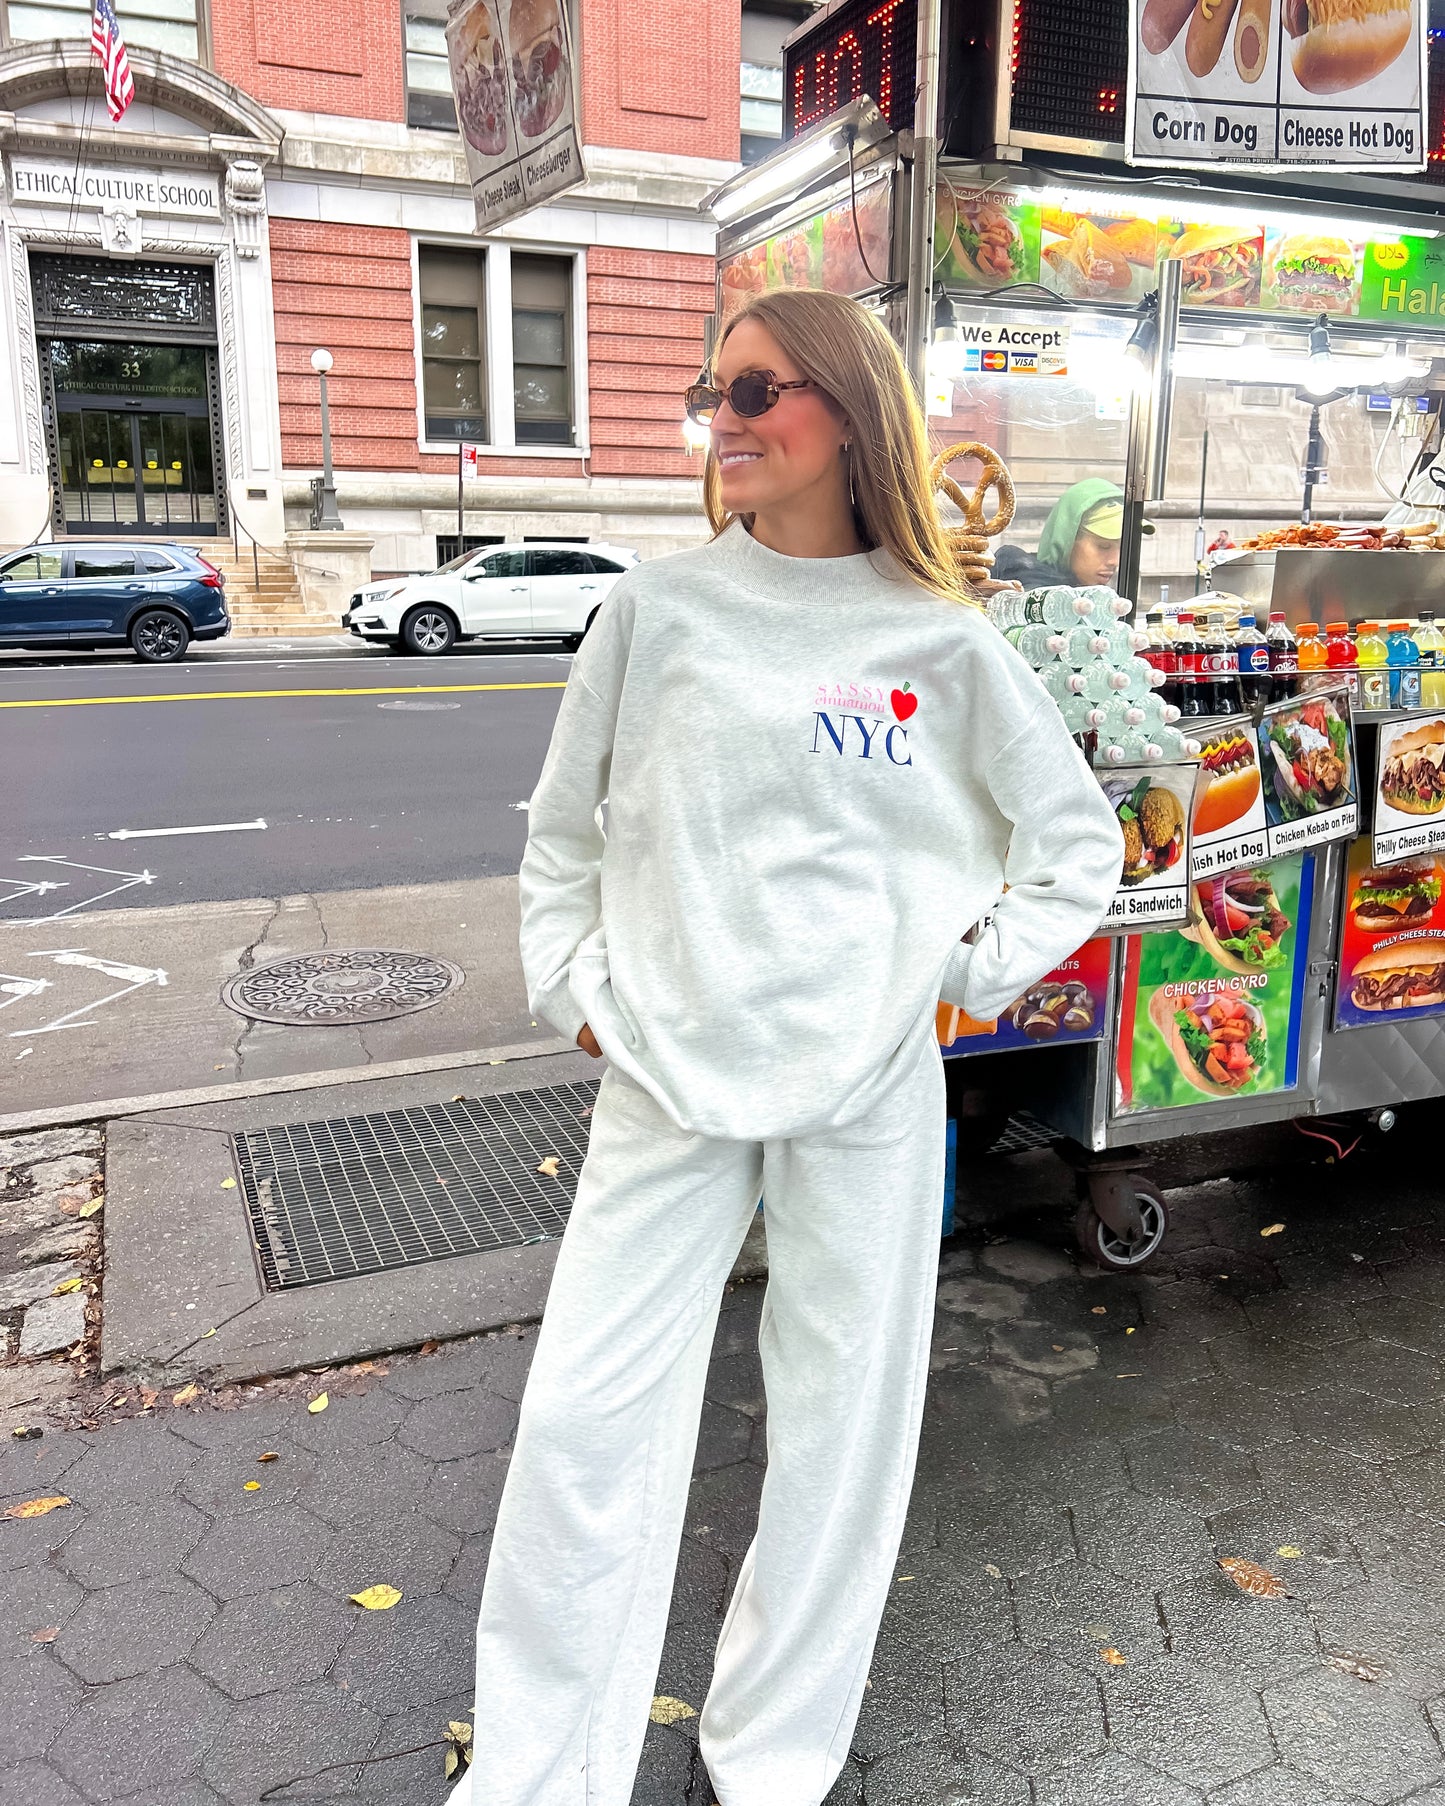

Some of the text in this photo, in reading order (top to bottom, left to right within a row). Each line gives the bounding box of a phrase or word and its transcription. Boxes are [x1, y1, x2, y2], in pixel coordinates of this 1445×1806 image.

[1152, 111, 1258, 151] Corn Dog
[1284, 118, 1414, 153] Cheese Hot Dog
[526, 147, 572, 186] Cheeseburger
[15, 171, 218, 209] ETHICAL CULTURE SCHOOL
[503, 174, 521, 200] Steak
[1378, 245, 1405, 260] حلال
[962, 326, 1062, 350] We Accept
[121, 362, 142, 378] 33
[1014, 357, 1034, 367] VISA
[97, 383, 130, 392] CULTURE
[818, 682, 884, 701] SASSY
[808, 711, 913, 767] NYC
[1275, 813, 1355, 845] Chicken Kebab on Pita
[1217, 847, 1238, 864] Hot
[1241, 842, 1263, 857] Dog
[1376, 839, 1397, 855] Philly
[1398, 835, 1426, 849] Cheese
[1129, 894, 1182, 914] Sandwich
[1372, 935, 1398, 952] PHILLY
[1399, 929, 1427, 940] CHEESE
[1164, 973, 1268, 998] CHICKEN GYRO
